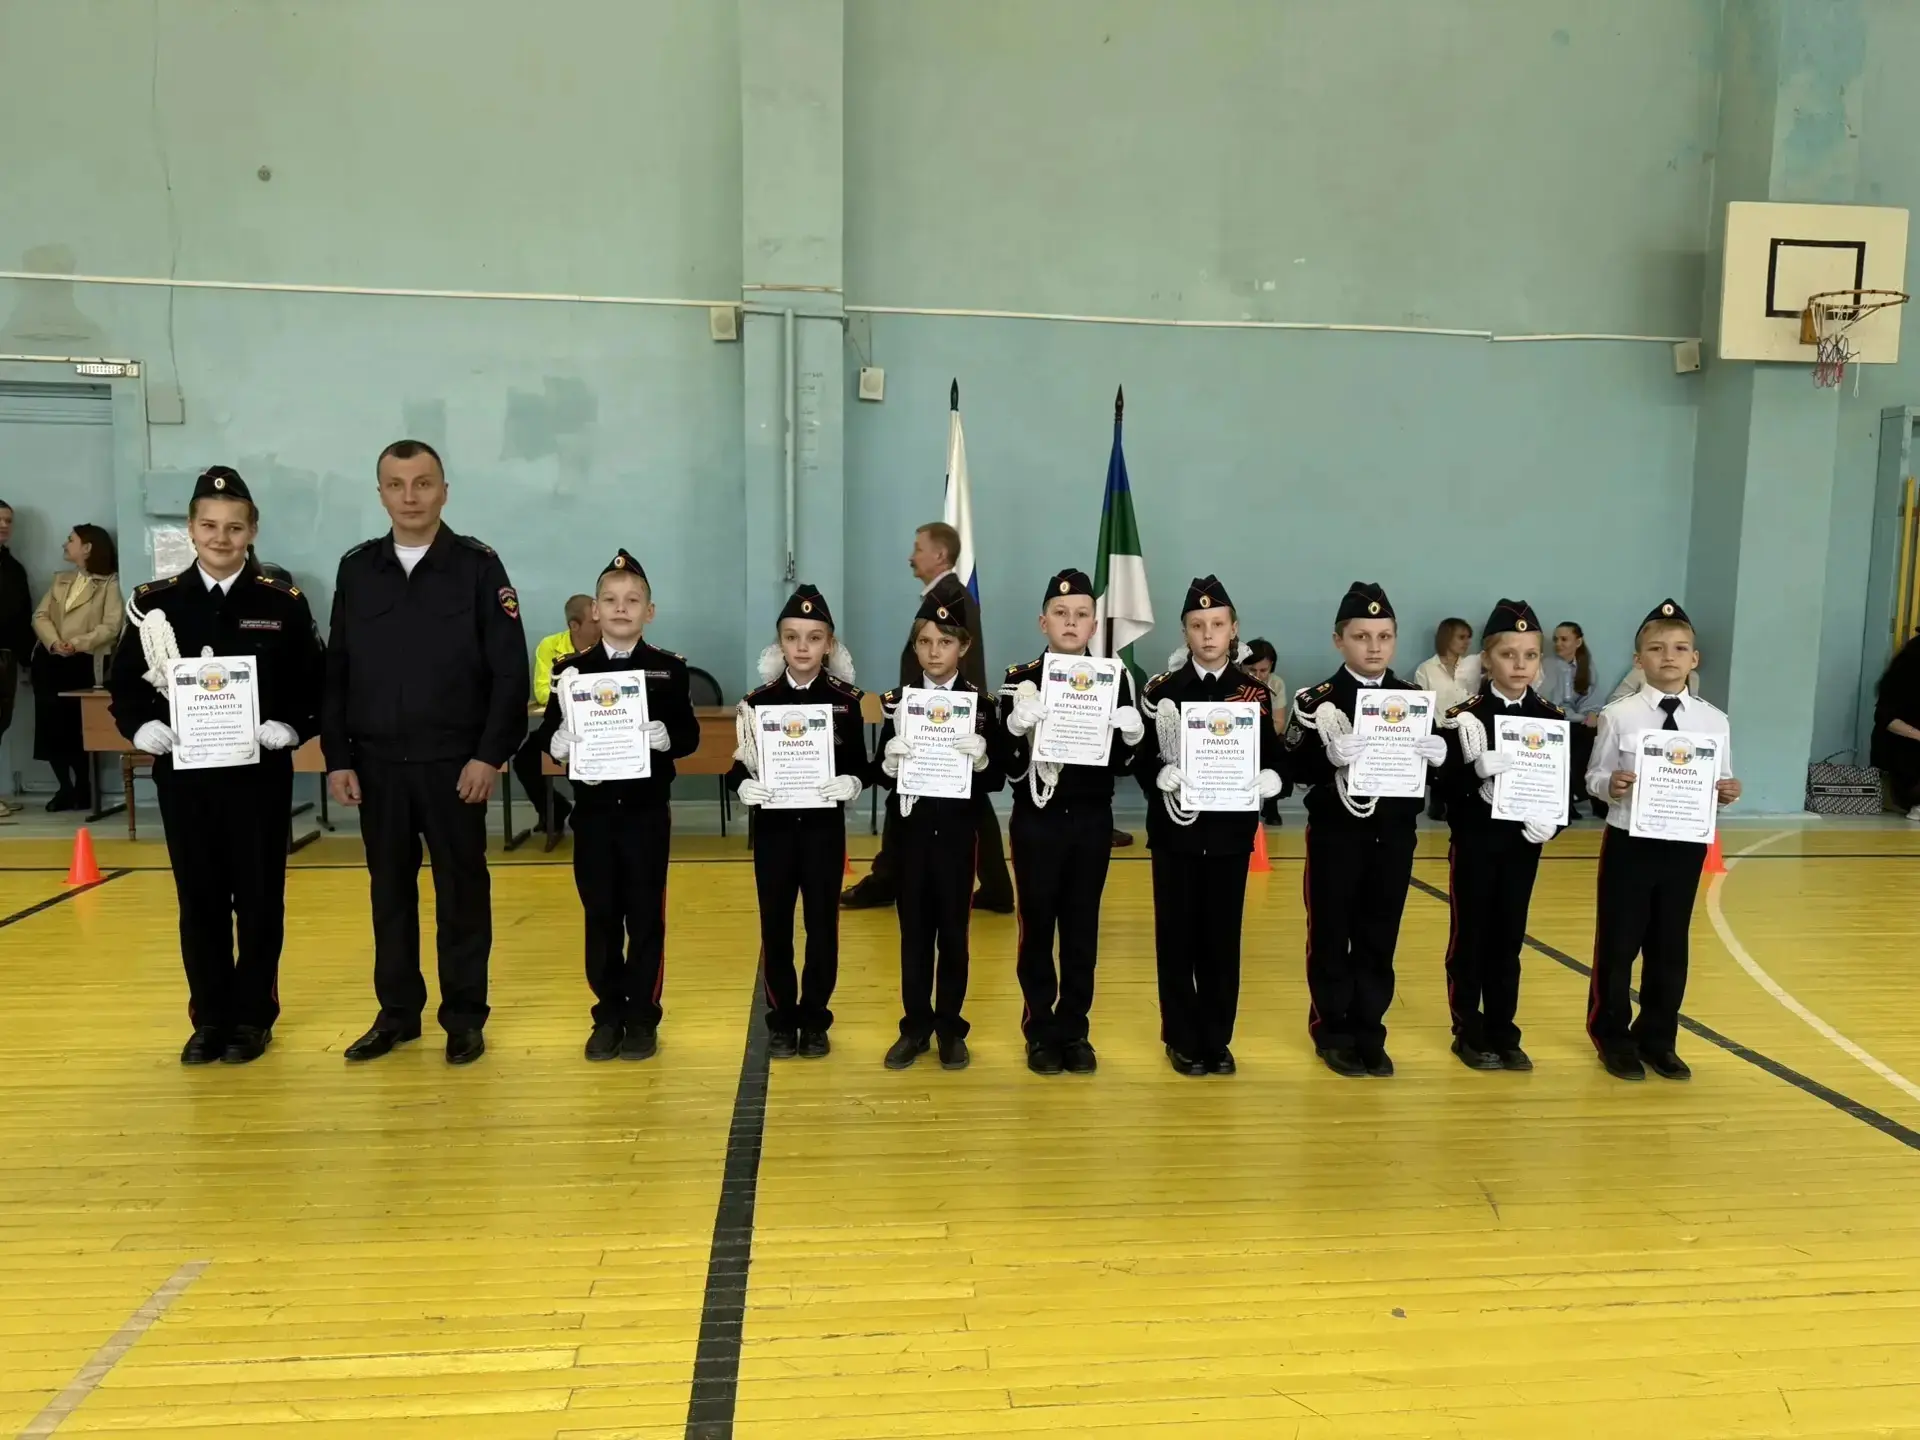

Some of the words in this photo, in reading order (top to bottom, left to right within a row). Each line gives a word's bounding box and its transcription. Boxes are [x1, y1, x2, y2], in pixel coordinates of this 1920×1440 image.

[194, 693, 236, 702] ГРАМОТА
[1062, 692, 1098, 702] ГРАМОТА
[1054, 703, 1102, 711] НАГРАЖДАЮТСЯ
[590, 708, 628, 717] ГРАМОТА
[920, 725, 956, 734] ГРАМОТА
[1517, 751, 1552, 760] ГРАМОТА
[1659, 767, 1698, 776] ГРАМОТА
[1650, 777, 1702, 785] НАГРАЖДАЮТСЯ
